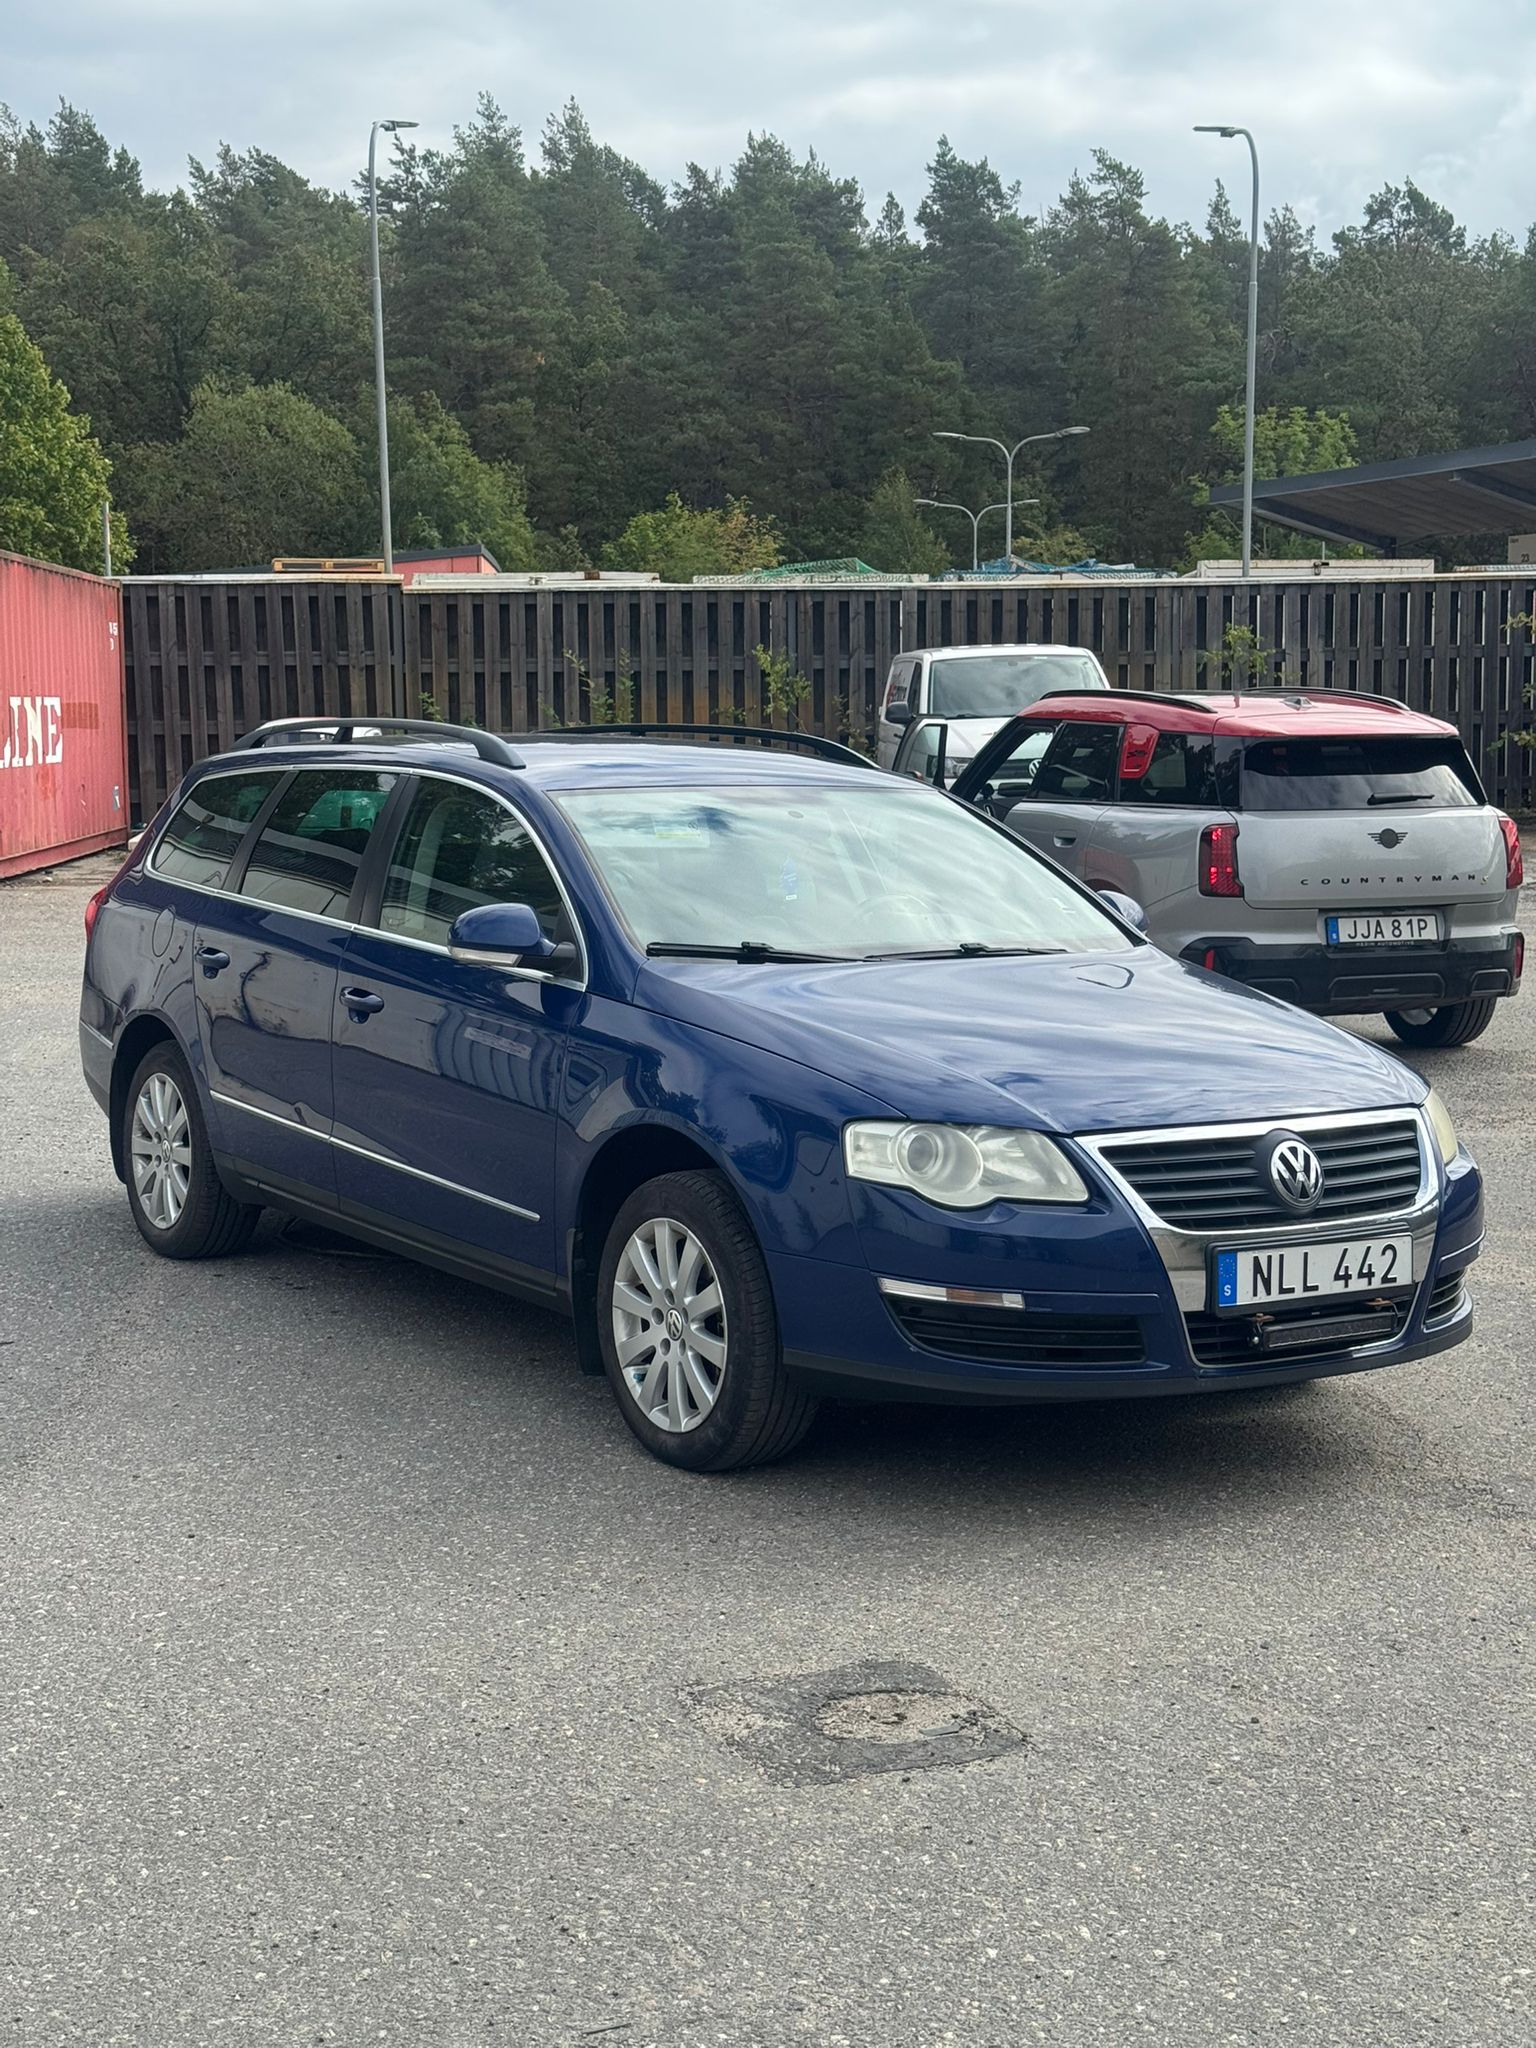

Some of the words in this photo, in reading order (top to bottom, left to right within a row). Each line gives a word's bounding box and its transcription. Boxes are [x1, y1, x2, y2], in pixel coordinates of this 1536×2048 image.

[1300, 874, 1475, 885] COUNTRYMAN
[1347, 920, 1385, 939] JJA
[1391, 918, 1428, 938] 81P
[1252, 1251, 1319, 1297] NLL
[1334, 1243, 1398, 1288] 442
[1224, 1285, 1231, 1296] S
